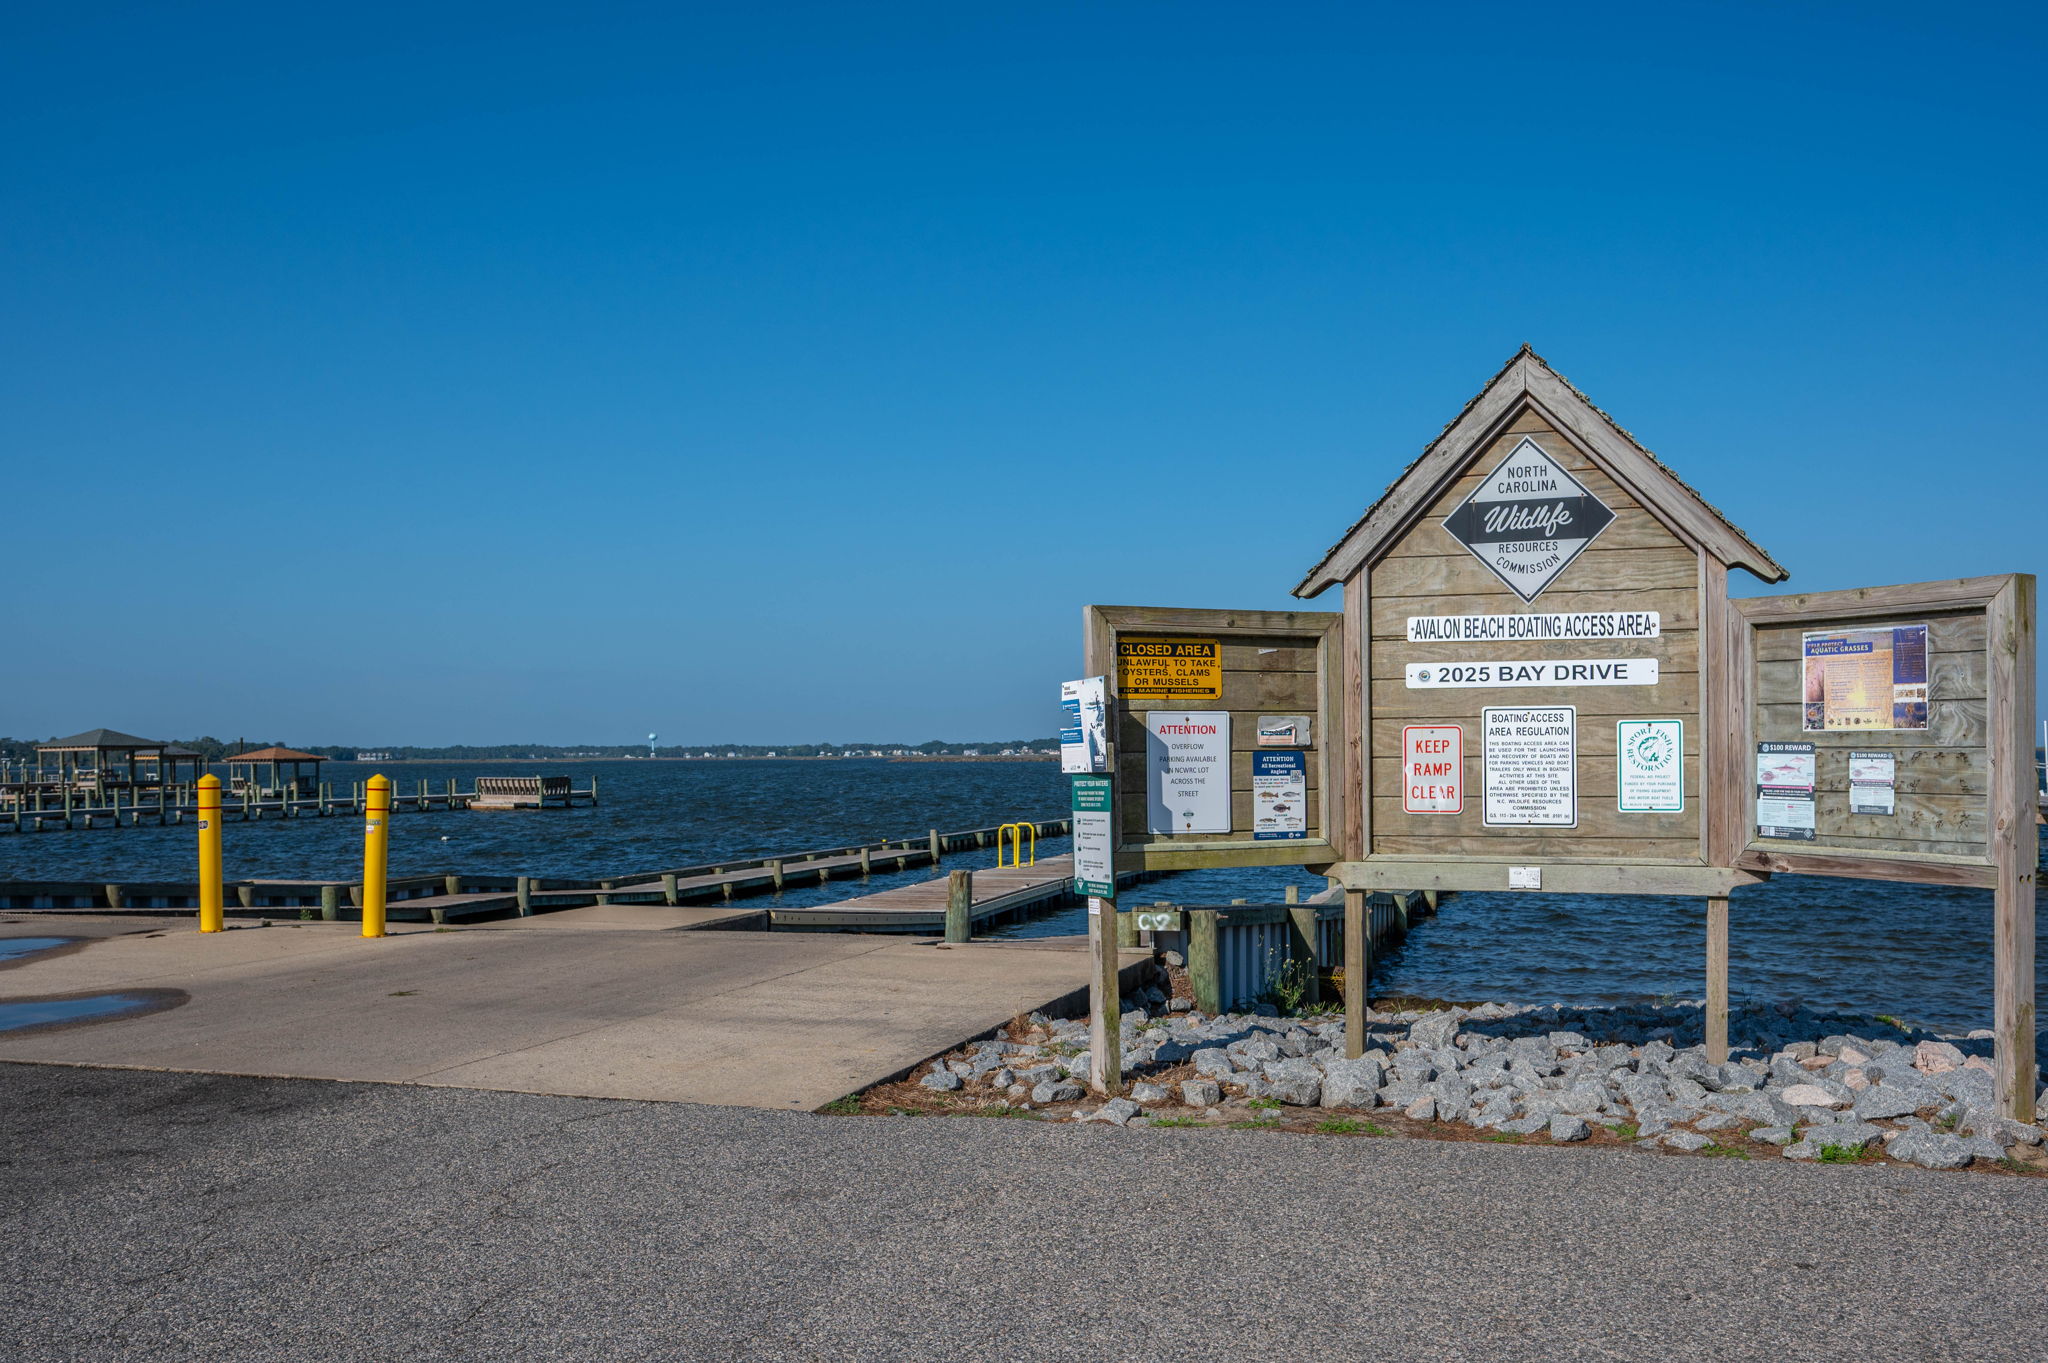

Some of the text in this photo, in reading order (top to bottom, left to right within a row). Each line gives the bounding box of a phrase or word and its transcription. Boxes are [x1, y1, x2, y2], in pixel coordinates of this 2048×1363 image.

[1508, 465, 1547, 478] NORTH
[1498, 480, 1557, 493] CAROLINA
[1484, 502, 1573, 537] Wildlife
[1499, 542, 1557, 553] RESOURCES
[1496, 554, 1560, 574] COMMISSION
[1414, 614, 1652, 639] AVALON BEACH BOATING ACCESS AREA
[1121, 644, 1211, 656] CLOSED AREA
[1439, 664, 1628, 682] 2025 BAY DRIVE
[1492, 714, 1564, 722] BOATING ACCESS
[1160, 725, 1216, 734] ATTENTION
[1489, 727, 1569, 736] AREA REGULATION
[1628, 728, 1672, 746] SPORT FISH
[1416, 740, 1449, 753] KEEP
[1414, 763, 1452, 776] RAMP
